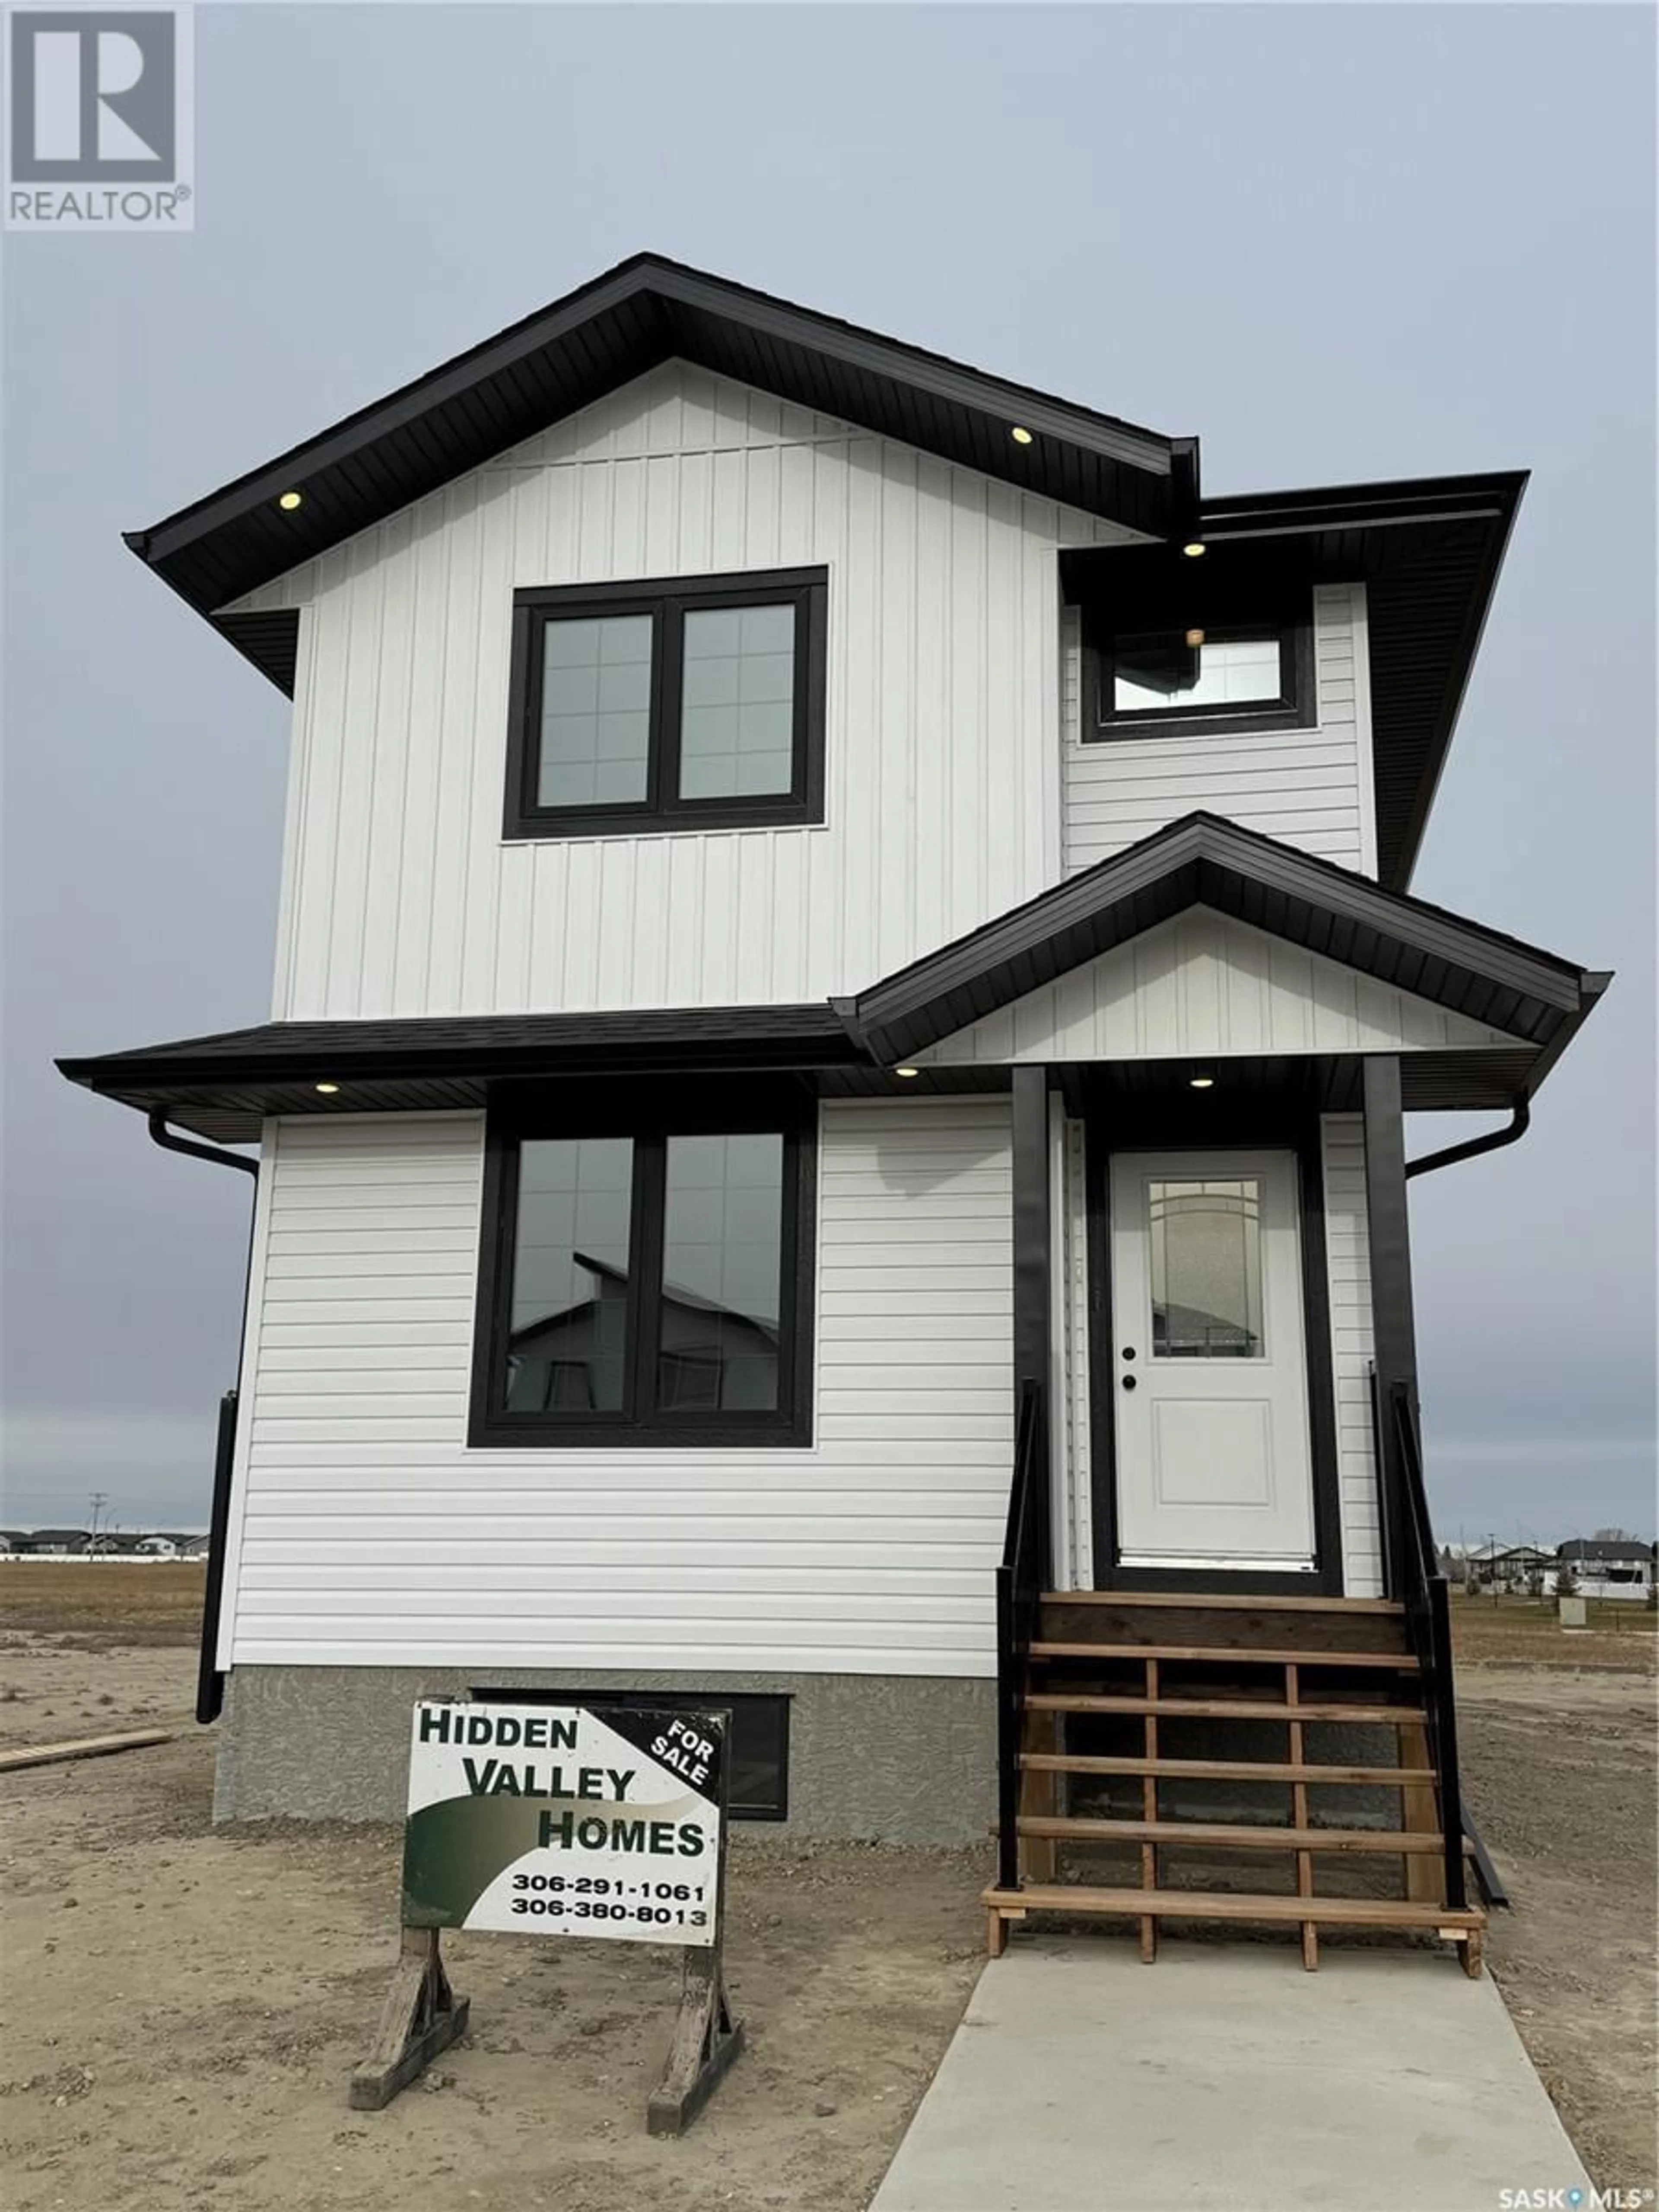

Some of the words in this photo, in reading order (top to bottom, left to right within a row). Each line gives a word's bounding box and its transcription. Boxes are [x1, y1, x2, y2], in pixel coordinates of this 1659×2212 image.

[420, 1708, 578, 1749] HIDDEN
[667, 1720, 715, 1763] FOR
[463, 1758, 636, 1802] VALLEY
[651, 1736, 709, 1786] SALE
[538, 1810, 704, 1857] HOMES
[512, 1874, 705, 1902] 306-291-1061
[512, 1899, 707, 1926] 306-380-8013
